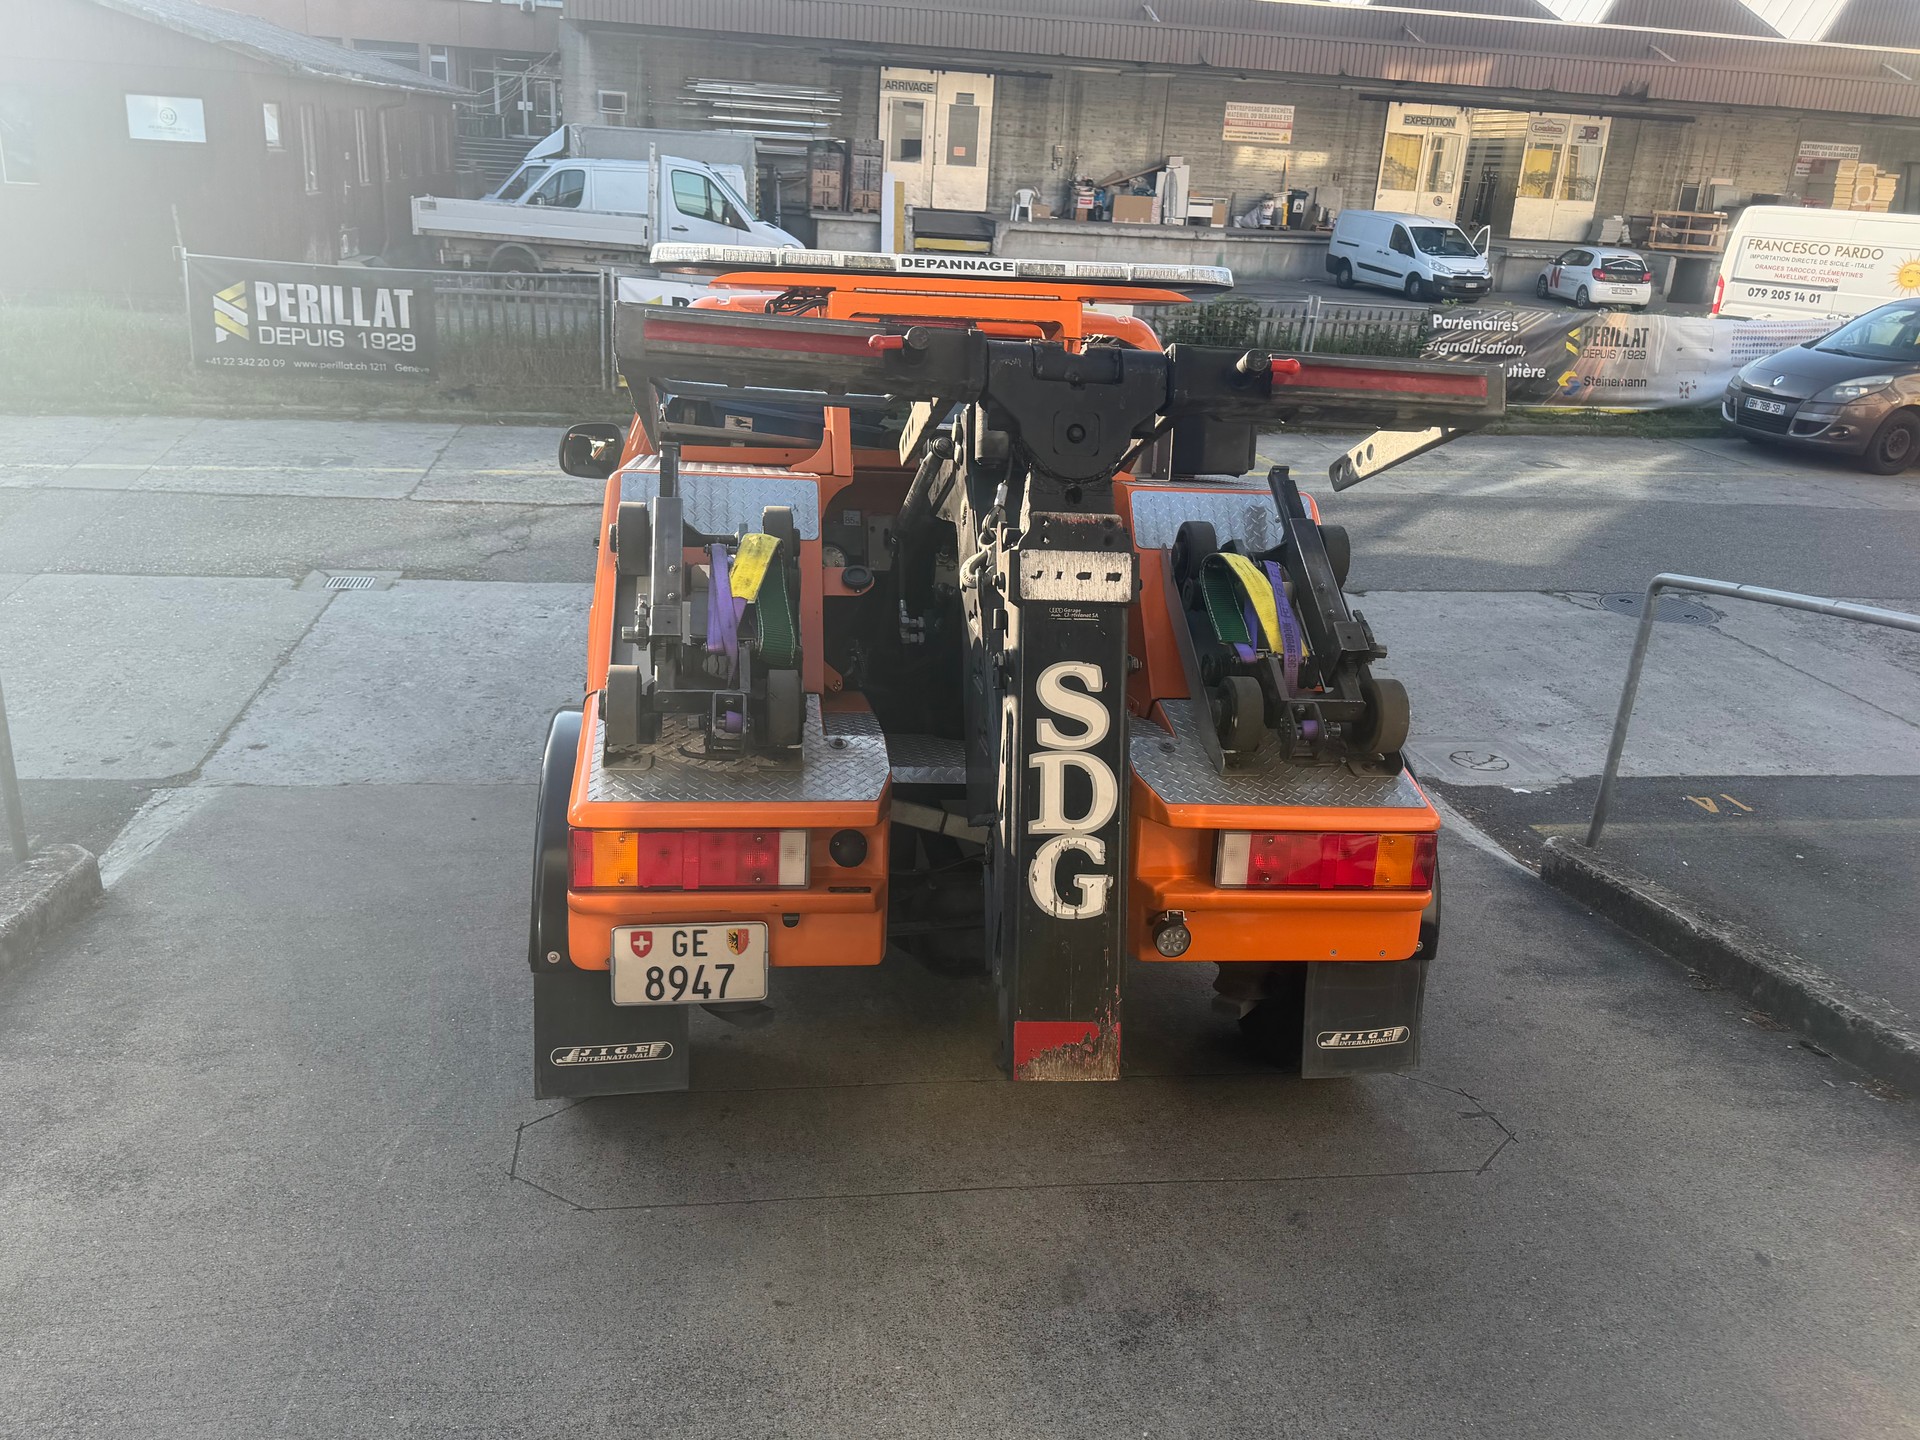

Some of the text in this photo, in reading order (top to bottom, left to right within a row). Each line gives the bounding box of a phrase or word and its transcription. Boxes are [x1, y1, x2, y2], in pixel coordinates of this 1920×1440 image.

[885, 80, 933, 92] ARRIVAGE
[1404, 115, 1455, 127] EXPEDITION
[1747, 238, 1884, 260] FRANCESCO PARDO
[901, 258, 1014, 271] DEPANNAGE
[1750, 254, 1790, 262] IMPORTATION
[1791, 257, 1817, 265] DIRECTE
[1550, 266, 1562, 289] N
[1755, 264, 1863, 279] ORANGES TAROCCO, CLÉMENTINES
[1774, 273, 1839, 284] NAVELLINE, CITRONS
[1748, 287, 1821, 304] 079 205 14 01
[254, 281, 414, 329] PERILLAT
[1432, 314, 1519, 332] Partenaires
[258, 326, 417, 352] DEPUIS 1929
[1583, 327, 1649, 349] PERILLAT
[1426, 338, 1528, 357] signalisation,
[1582, 349, 1647, 360] DEPUIS 1929
[204, 358, 221, 366] +41
[223, 358, 235, 366] 22
[237, 358, 256, 367] 342
[257, 359, 270, 367] 20
[273, 360, 286, 368] 09
[293, 360, 368, 371] www.perillat.ch
[370, 363, 387, 371] 1211
[1583, 375, 1648, 388] Steinemann
[1028, 661, 1118, 920] SDG
[672, 929, 708, 958] GE
[645, 963, 735, 1001] 8947
[1339, 1037, 1392, 1046] INTERNATIONAL
[1341, 1030, 1393, 1040] JIGE
[578, 1052, 651, 1062] INTERNATIONAL
[580, 1045, 649, 1056] JIGE
